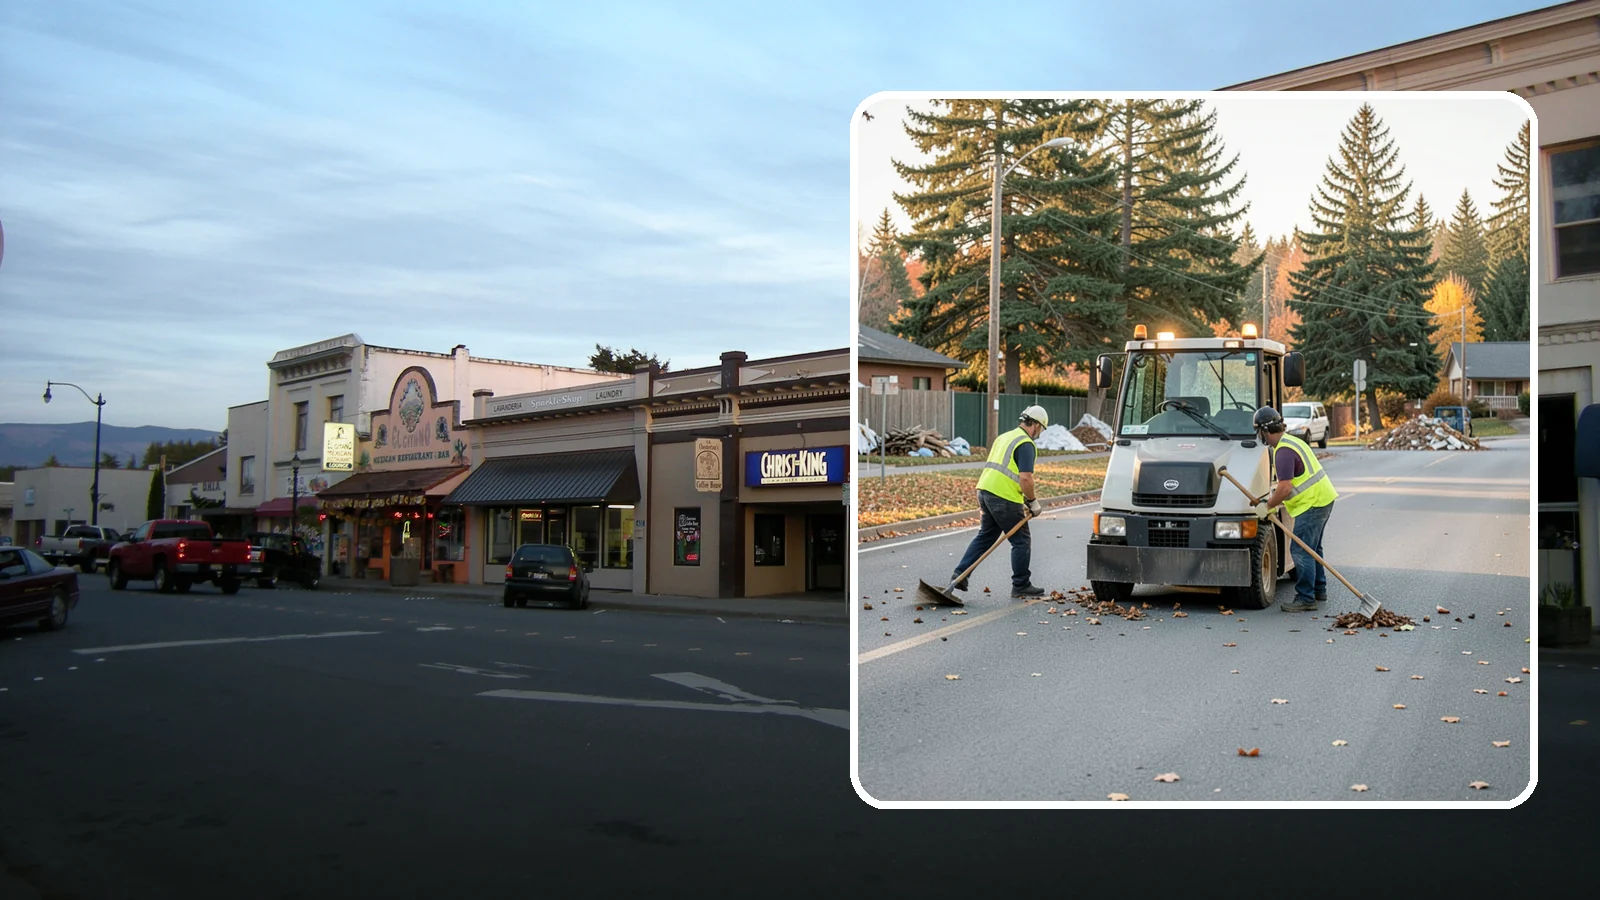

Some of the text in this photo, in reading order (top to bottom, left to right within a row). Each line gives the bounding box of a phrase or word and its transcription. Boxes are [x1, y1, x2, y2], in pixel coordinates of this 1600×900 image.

[595, 389, 623, 400] LAUNDRY
[494, 402, 522, 412] LAVANDERIA
[531, 394, 582, 409] Sparkle Shop
[373, 455, 396, 464] MEXICAN
[397, 451, 433, 462] RESTAURANT
[438, 450, 450, 459] BAR
[761, 450, 827, 478] CHRIST KING
[697, 481, 721, 489] Coffee House
